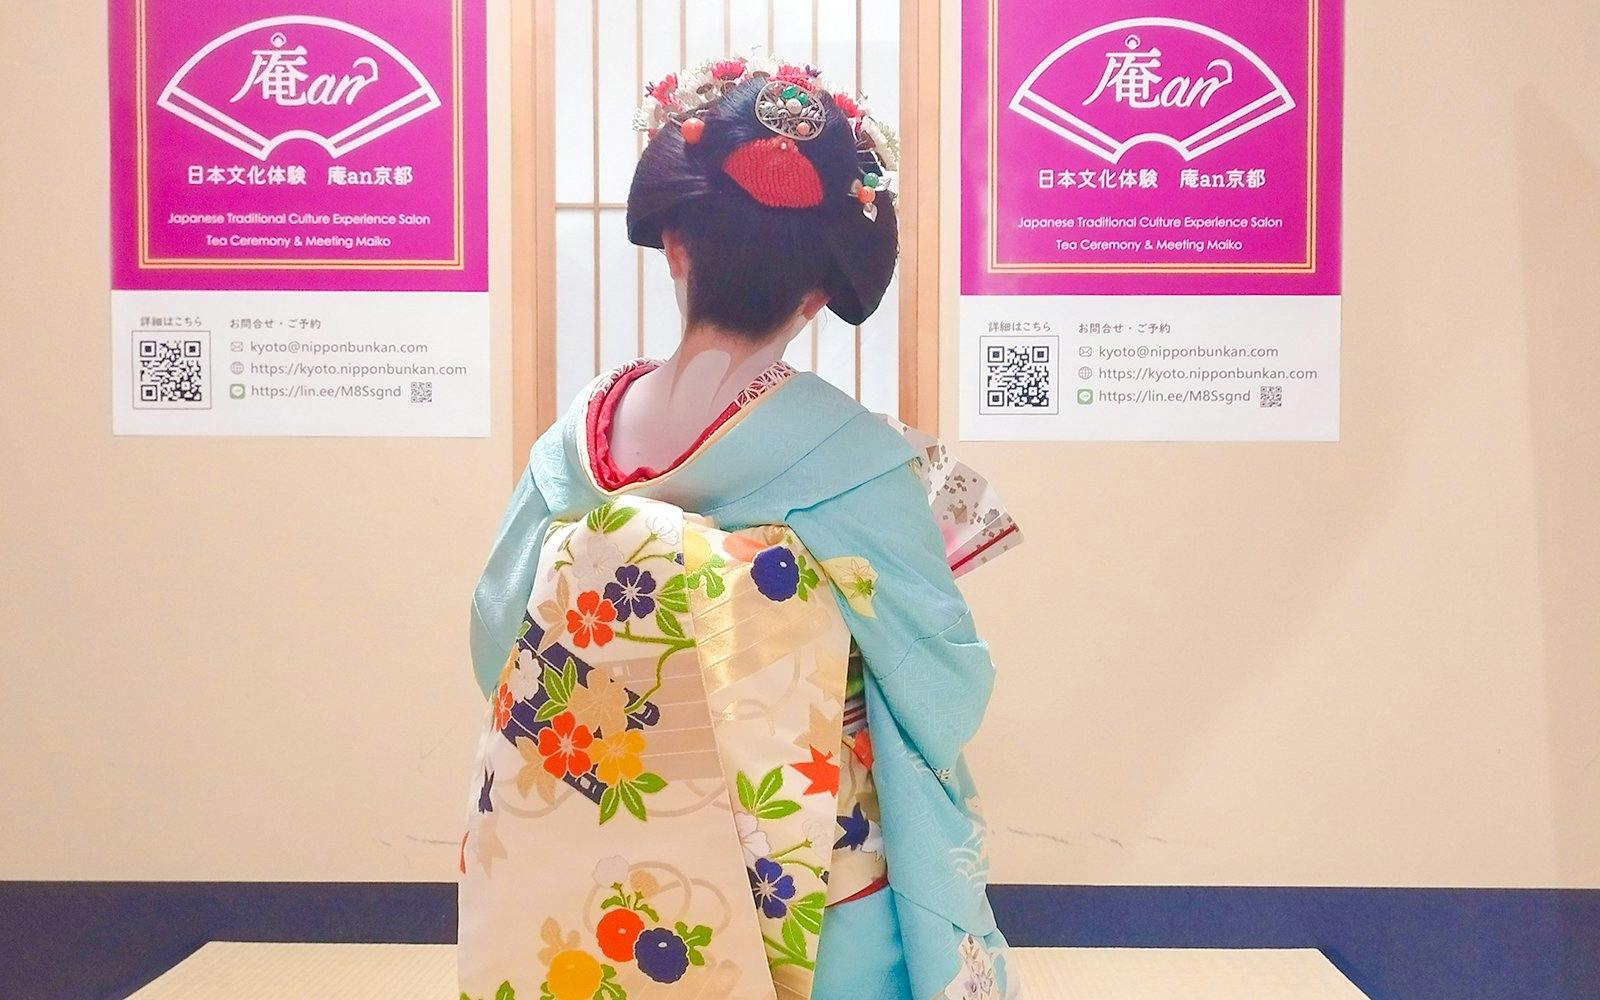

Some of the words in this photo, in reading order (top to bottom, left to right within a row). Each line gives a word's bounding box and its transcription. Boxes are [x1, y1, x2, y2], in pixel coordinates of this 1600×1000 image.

[188, 166, 307, 185] 日本文化体験
[327, 166, 413, 185] 庵an京都
[1038, 169, 1158, 189] 日本文化体験
[1180, 169, 1266, 189] 庵an京都
[168, 212, 224, 226] Japanese
[227, 212, 286, 224] Traditional
[288, 213, 330, 225] Culture
[332, 213, 396, 226] Experience
[399, 213, 430, 225] Salon
[1018, 217, 1075, 230] Japanese
[1077, 217, 1137, 228] Traditional
[1140, 217, 1182, 228] Culture
[1184, 217, 1248, 230] Experience
[1251, 217, 1283, 228] Salon
[206, 235, 228, 247] Tea
[229, 235, 291, 249] Ceremony
[294, 236, 303, 247] &
[305, 236, 353, 249] Meeting
[356, 236, 391, 247] Maiko
[1056, 239, 1078, 250] Tea
[1080, 239, 1141, 252] Ceremony
[1145, 239, 1153, 250] &
[1157, 239, 1204, 252] Meeting
[1208, 239, 1242, 250] Maiko
[140, 316, 202, 328] 詳細はこちら
[230, 318, 322, 329] お問合せ・ご予約
[988, 322, 1051, 333] 詳細はこちら
[1078, 323, 1171, 334] お問合せ・ご予約
[250, 341, 428, 355] kyoto@nipponbunkan.com
[1099, 345, 1279, 359] kyoto@nipponbunkan.com
[251, 362, 467, 377] https://kyoto.nipponbunkan.com
[1099, 367, 1318, 381] https://kyoto.nipponbunkan.com
[251, 385, 401, 399] https://lin.ee/M8Ssgnd
[1099, 389, 1251, 404] https://lin.ee/M8Ssgnd
